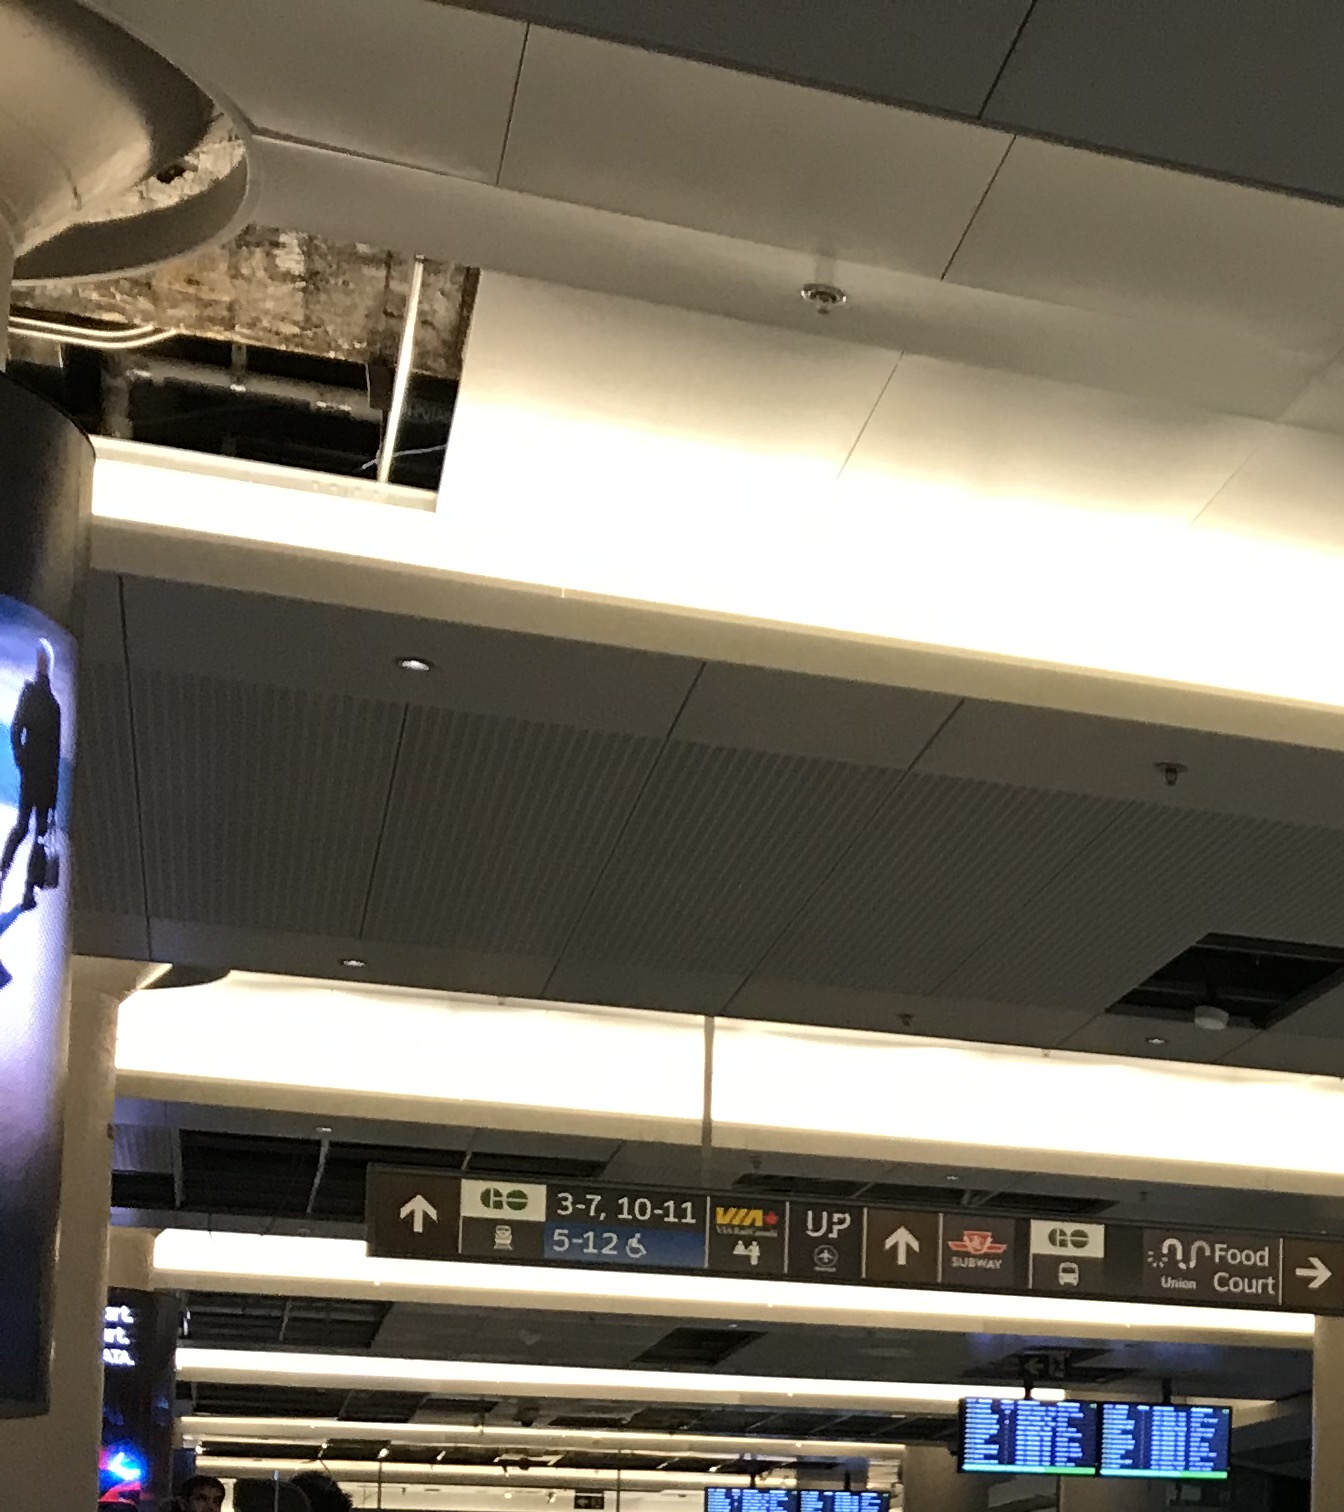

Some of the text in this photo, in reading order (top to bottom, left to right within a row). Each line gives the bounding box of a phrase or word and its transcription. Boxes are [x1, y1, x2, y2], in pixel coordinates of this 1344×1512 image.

[556, 1193, 697, 1224] 3-7, 10-11
[715, 1207, 763, 1227] VIA
[806, 1210, 851, 1240] UP
[553, 1230, 618, 1256] 5-12
[1214, 1243, 1269, 1267] Food
[951, 1256, 1003, 1270] SUBWAY
[1161, 1275, 1196, 1291] Union
[1213, 1271, 1276, 1296] Court
